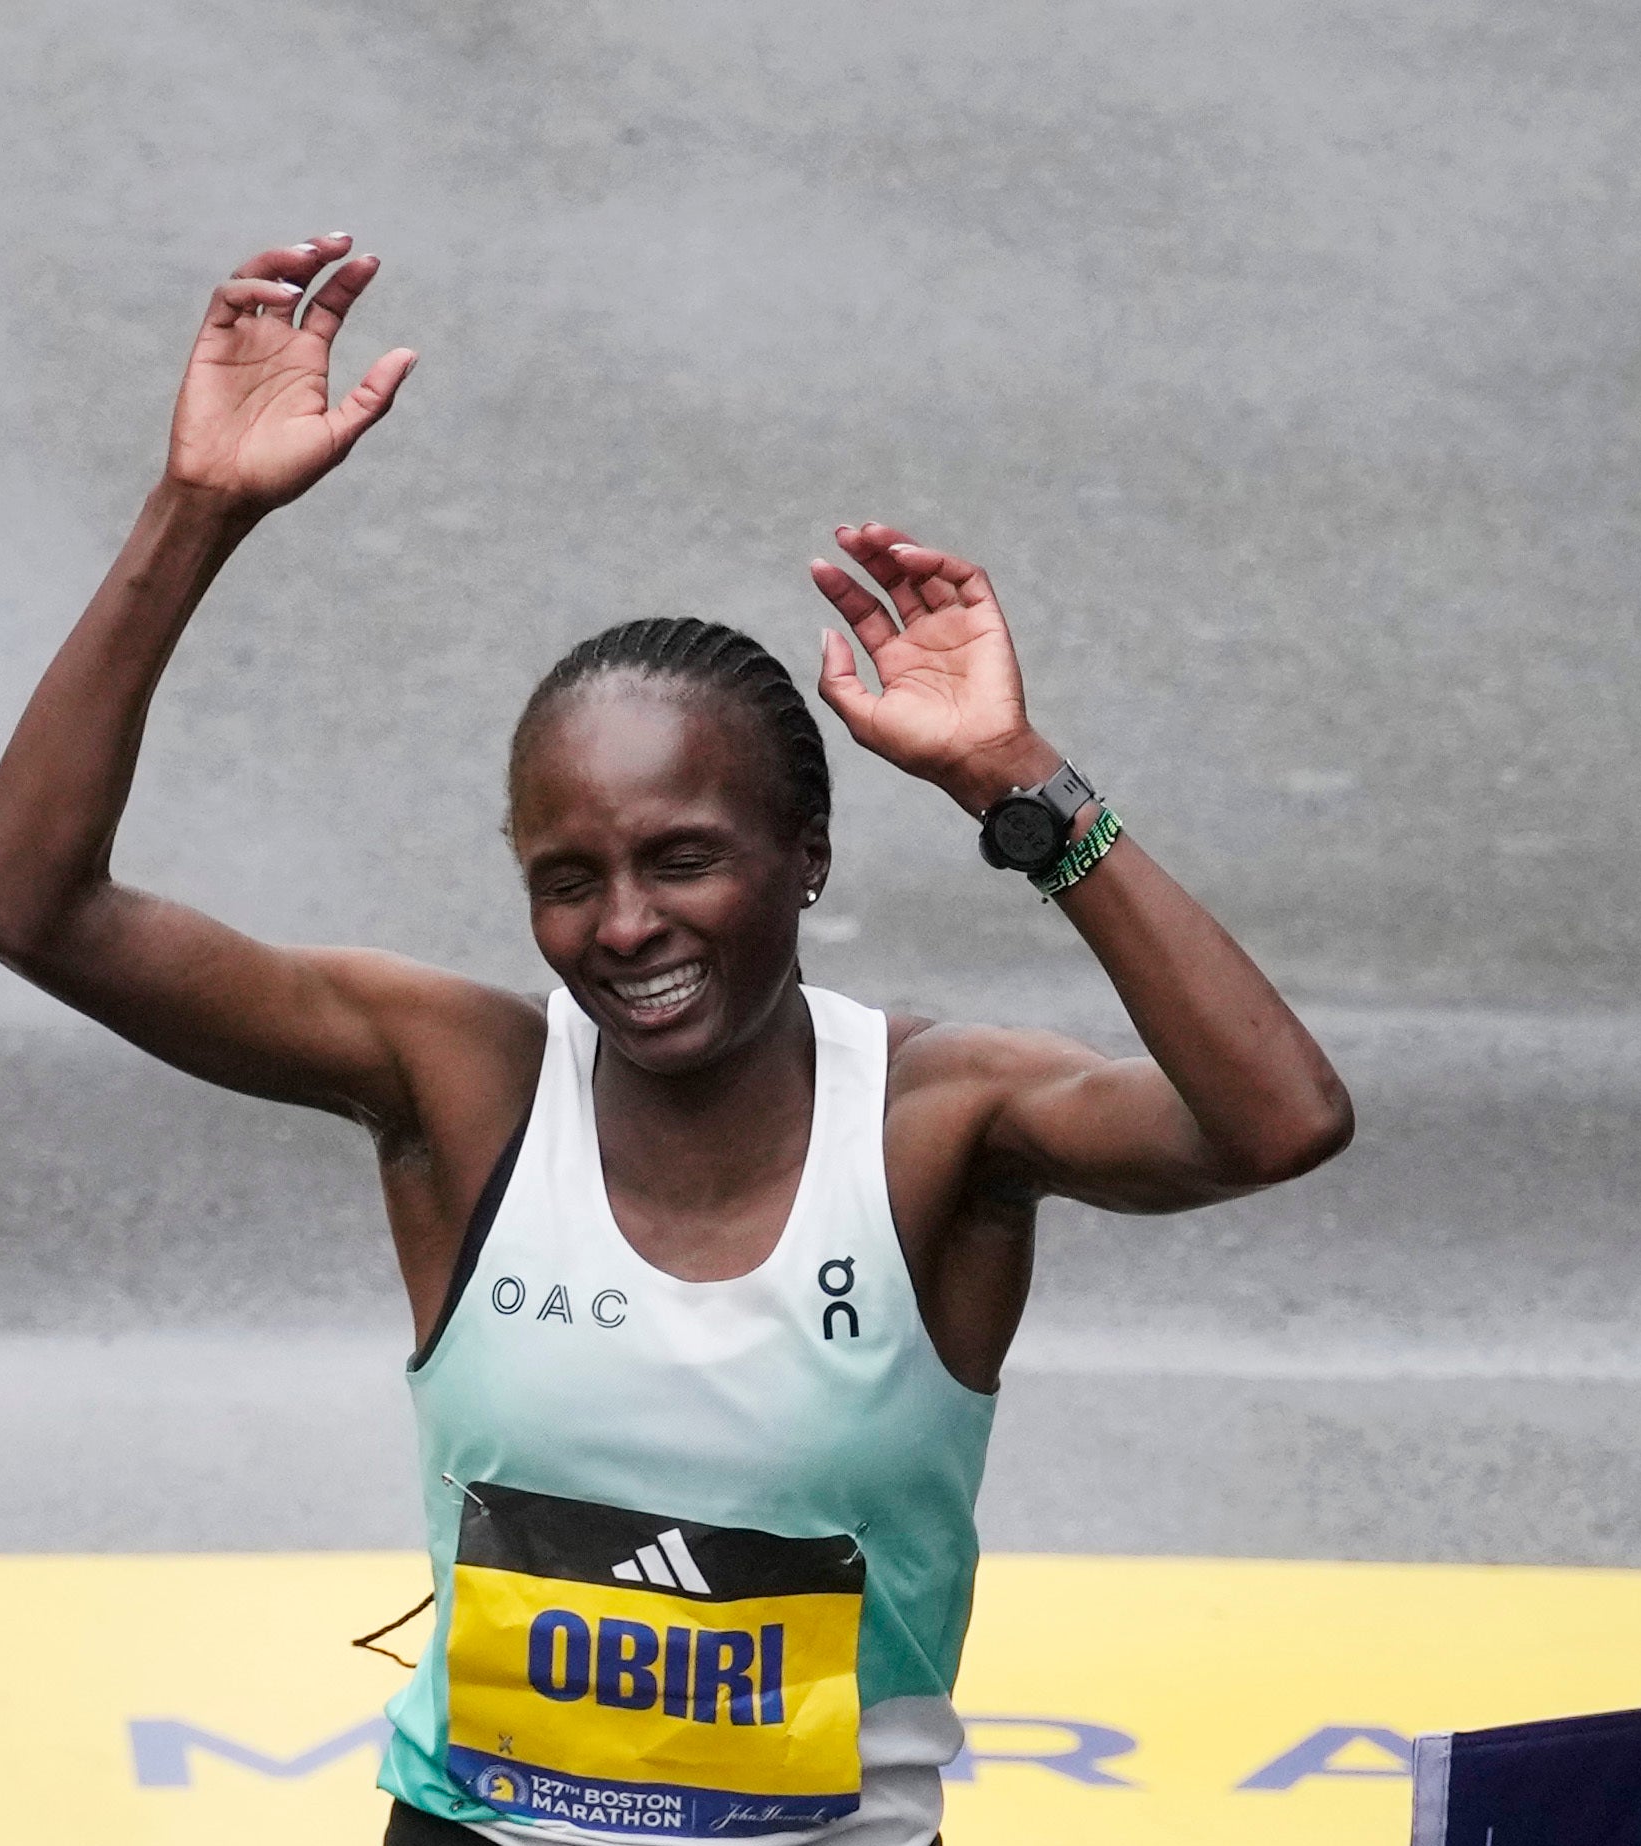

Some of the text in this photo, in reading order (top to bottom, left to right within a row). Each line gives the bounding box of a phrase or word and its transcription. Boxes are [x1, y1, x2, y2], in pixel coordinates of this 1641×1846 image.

[491, 1274, 628, 1329] OAC
[527, 1607, 786, 1728] OBIRI
[530, 1775, 581, 1797] 127TH
[583, 1787, 682, 1811] BOSTON
